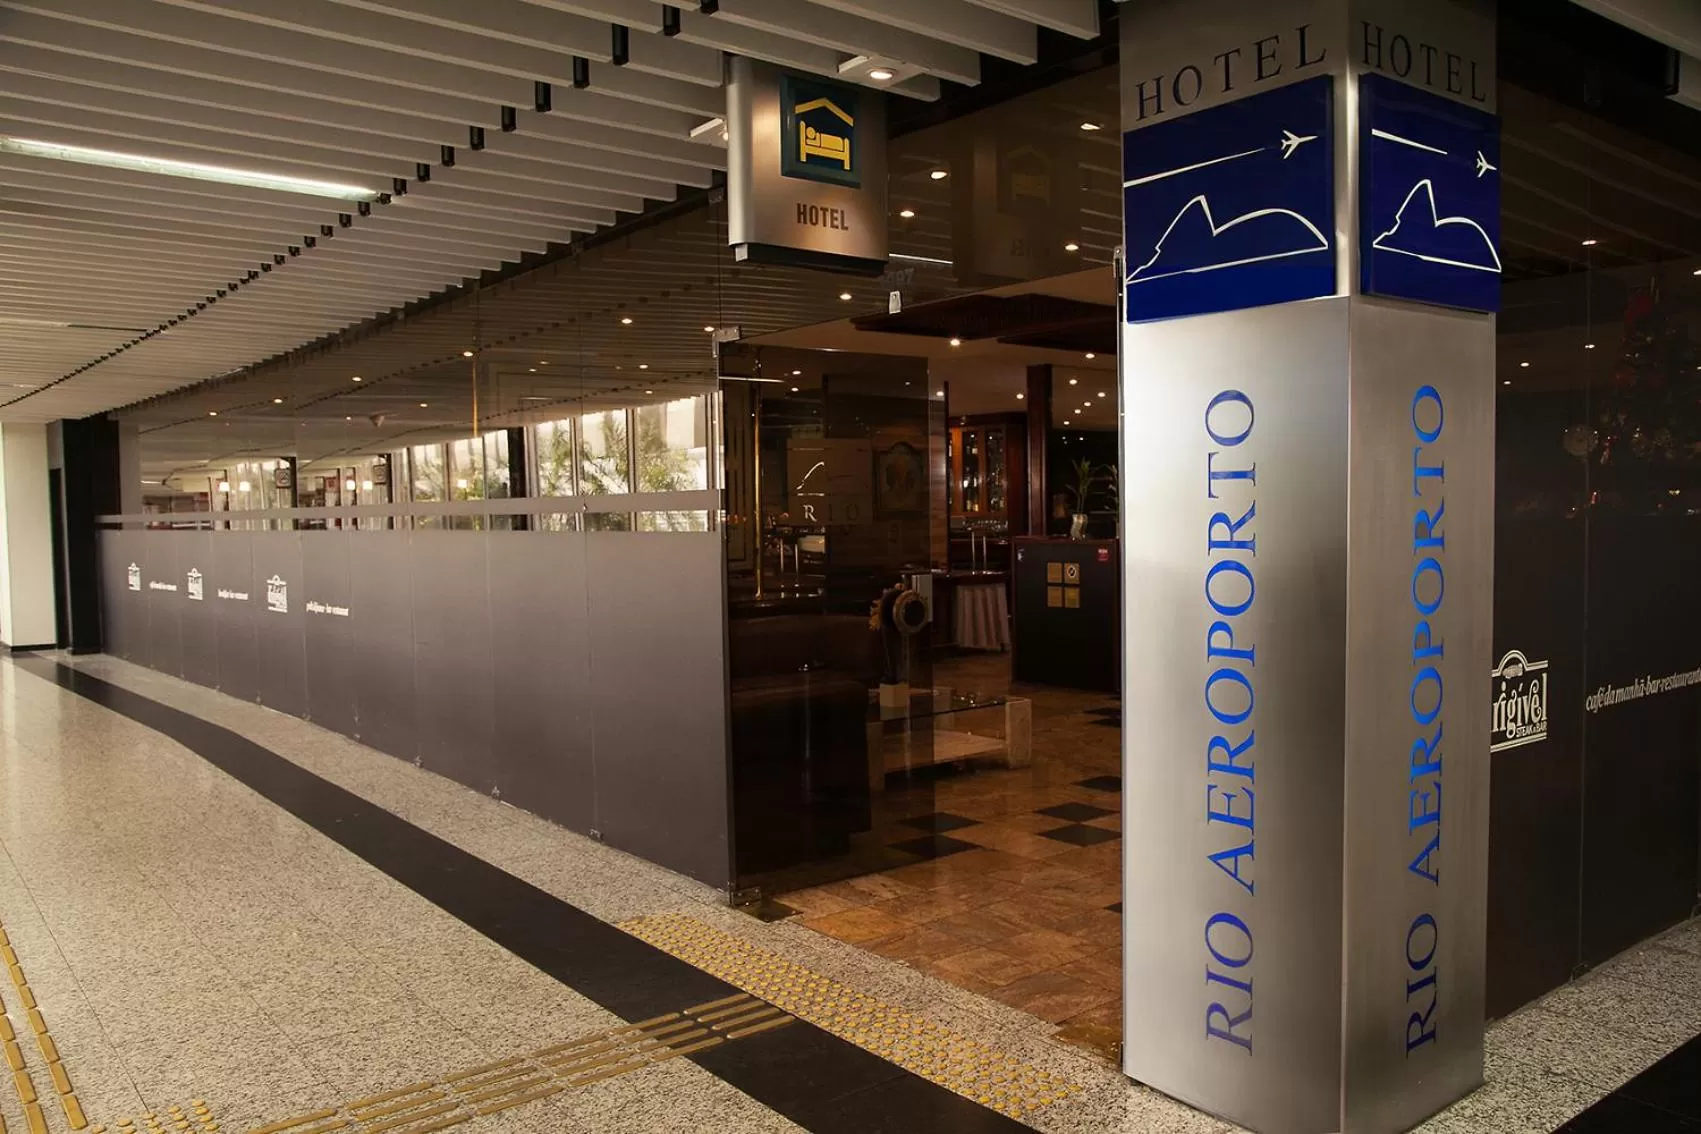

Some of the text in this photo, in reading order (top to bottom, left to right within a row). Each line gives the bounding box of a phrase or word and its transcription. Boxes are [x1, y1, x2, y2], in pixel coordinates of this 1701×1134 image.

[1135, 23, 1328, 121] HOTEL
[1360, 20, 1487, 103] HOTEL
[796, 203, 850, 231] HOTEL
[1205, 389, 1257, 1056] RIO AEROPORTO
[1406, 384, 1444, 1059] RIO AEROPORTO
[1491, 672, 1548, 739] rigível
